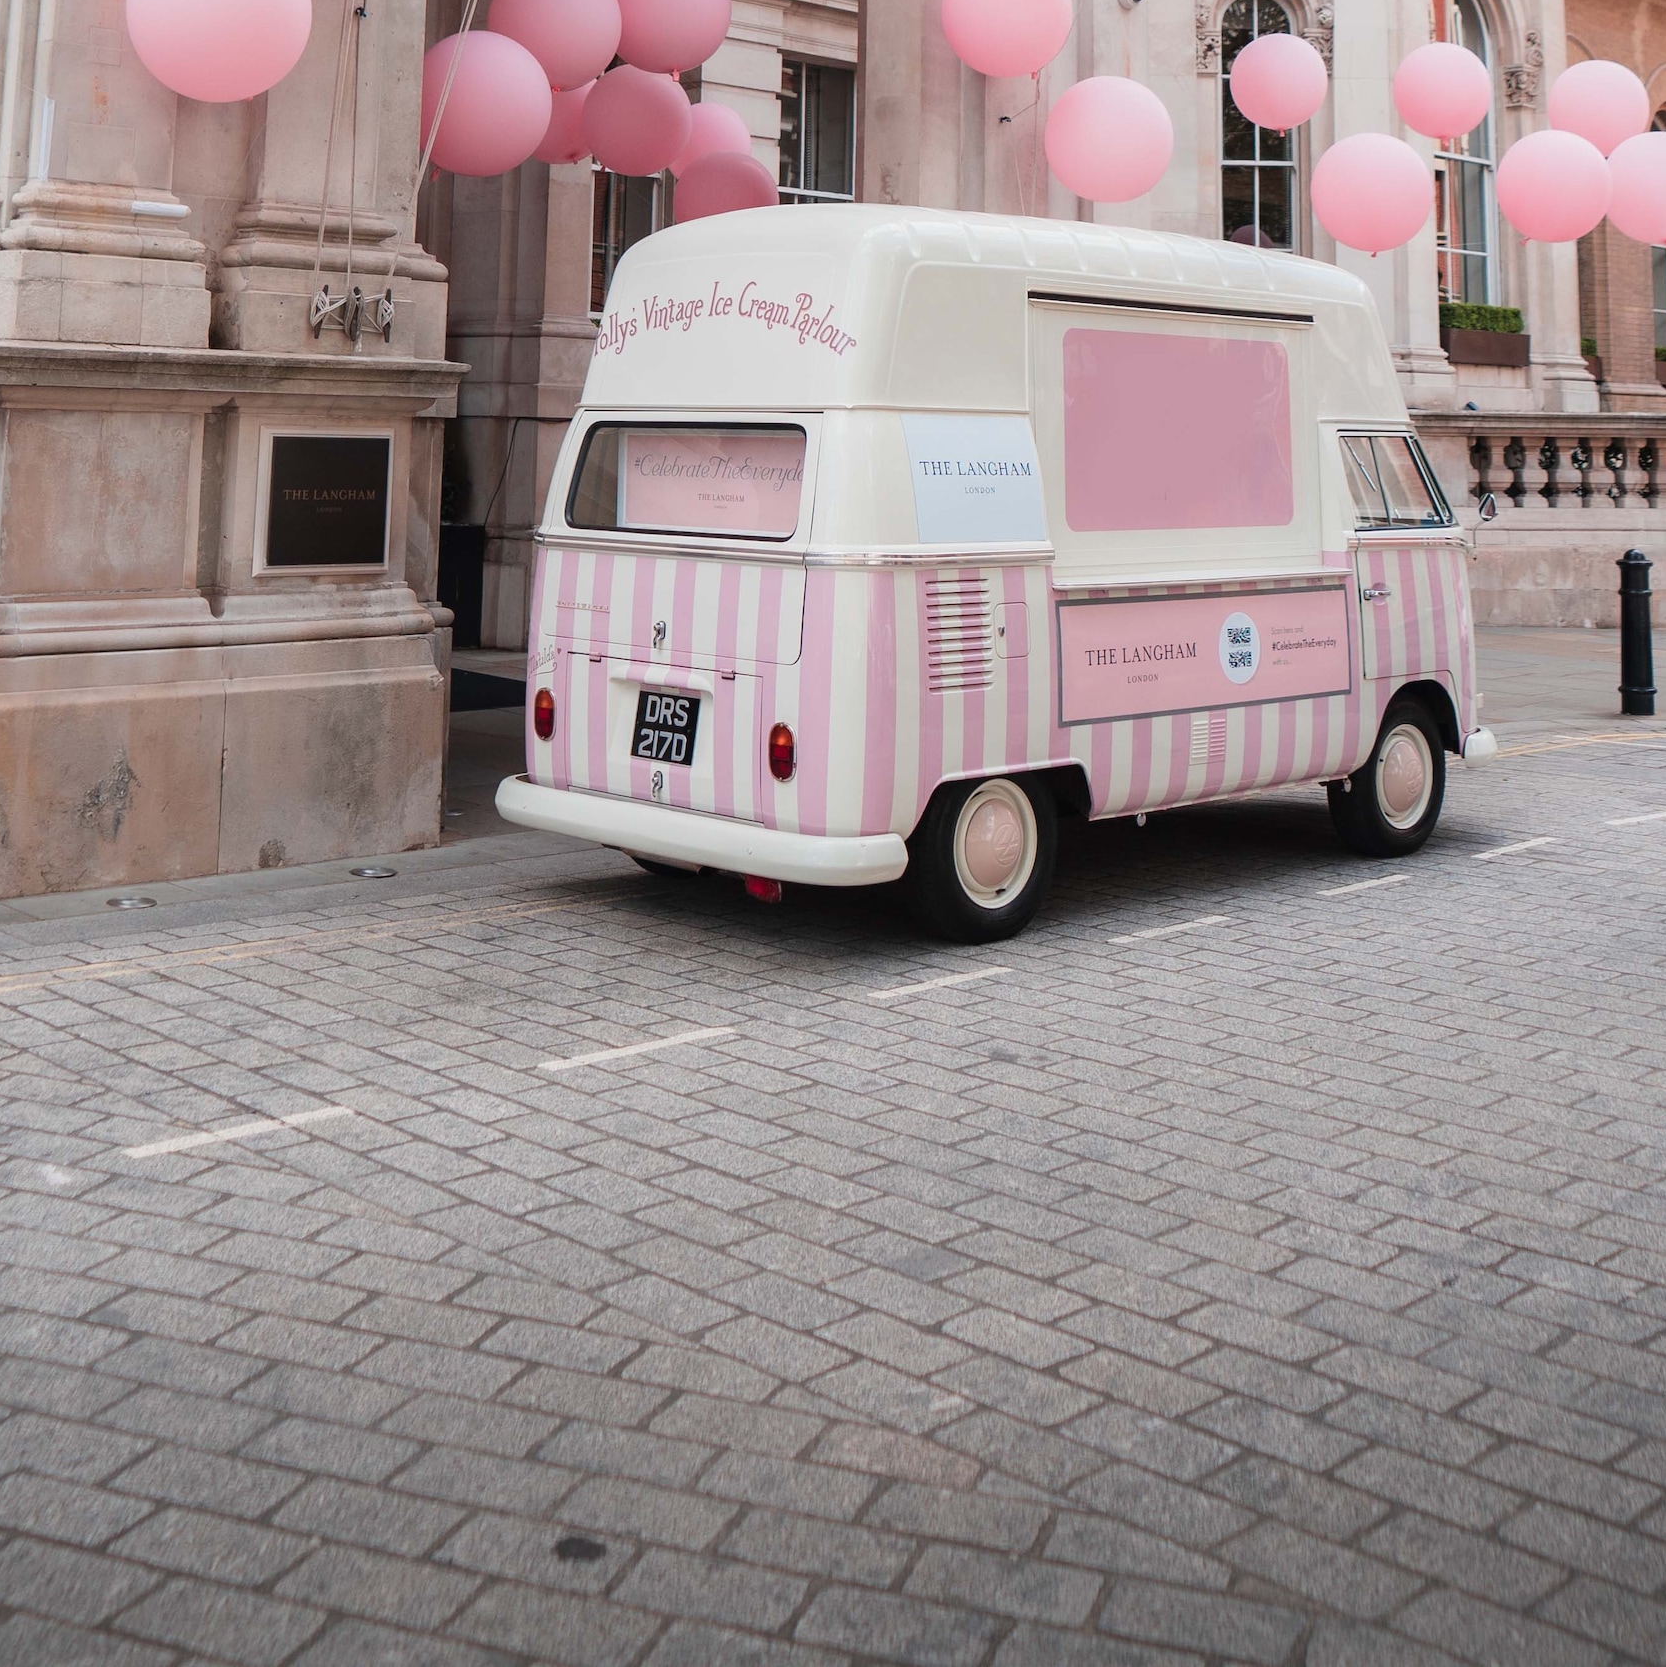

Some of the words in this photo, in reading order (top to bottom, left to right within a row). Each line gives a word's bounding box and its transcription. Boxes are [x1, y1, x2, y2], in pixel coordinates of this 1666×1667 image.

[643, 295, 704, 332] Vintage
[708, 281, 733, 317] Ice
[738, 281, 789, 330] Cream
[790, 292, 857, 356] Parlour
[919, 461, 953, 476] THE
[956, 461, 1032, 476] LANGHAM
[283, 489, 310, 500] THE
[313, 489, 376, 501] LANGHAM
[697, 493, 711, 501] THE
[712, 493, 745, 502] LANGHAM
[964, 486, 996, 494] LONDON
[1271, 636, 1337, 651] #CelebrateTheEveryday
[1085, 648, 1118, 667] THE
[1122, 642, 1198, 664] LANGHAM
[1127, 674, 1159, 684] LONDON
[644, 694, 690, 727] DRS
[637, 728, 688, 762] 217D
